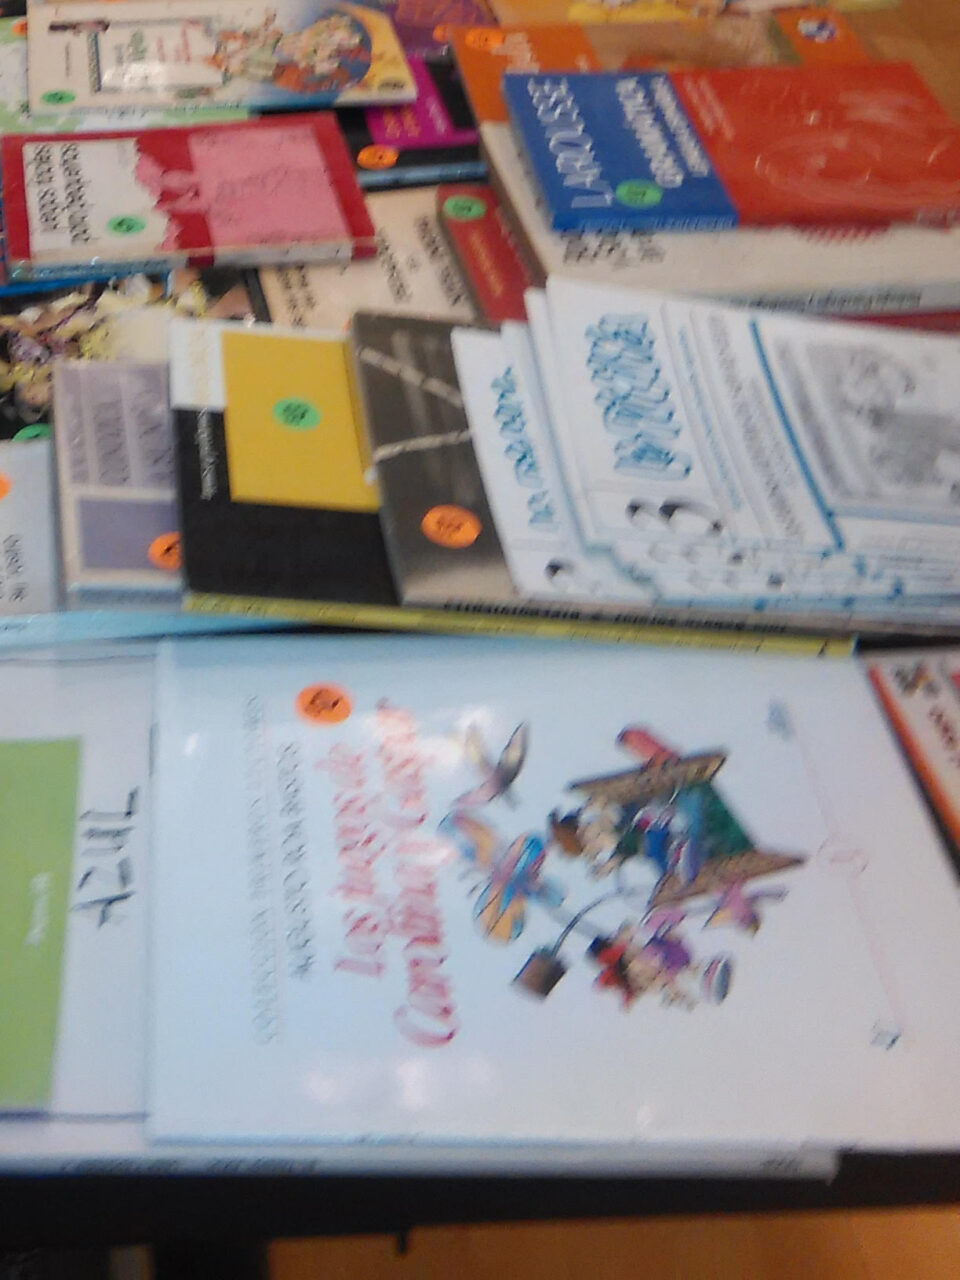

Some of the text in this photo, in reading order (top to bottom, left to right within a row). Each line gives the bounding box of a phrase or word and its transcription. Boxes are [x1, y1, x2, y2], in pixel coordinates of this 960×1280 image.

[526, 77, 615, 209] LAROUSSE
[332, 907, 385, 979] Los
[385, 865, 456, 1048] Carolina
